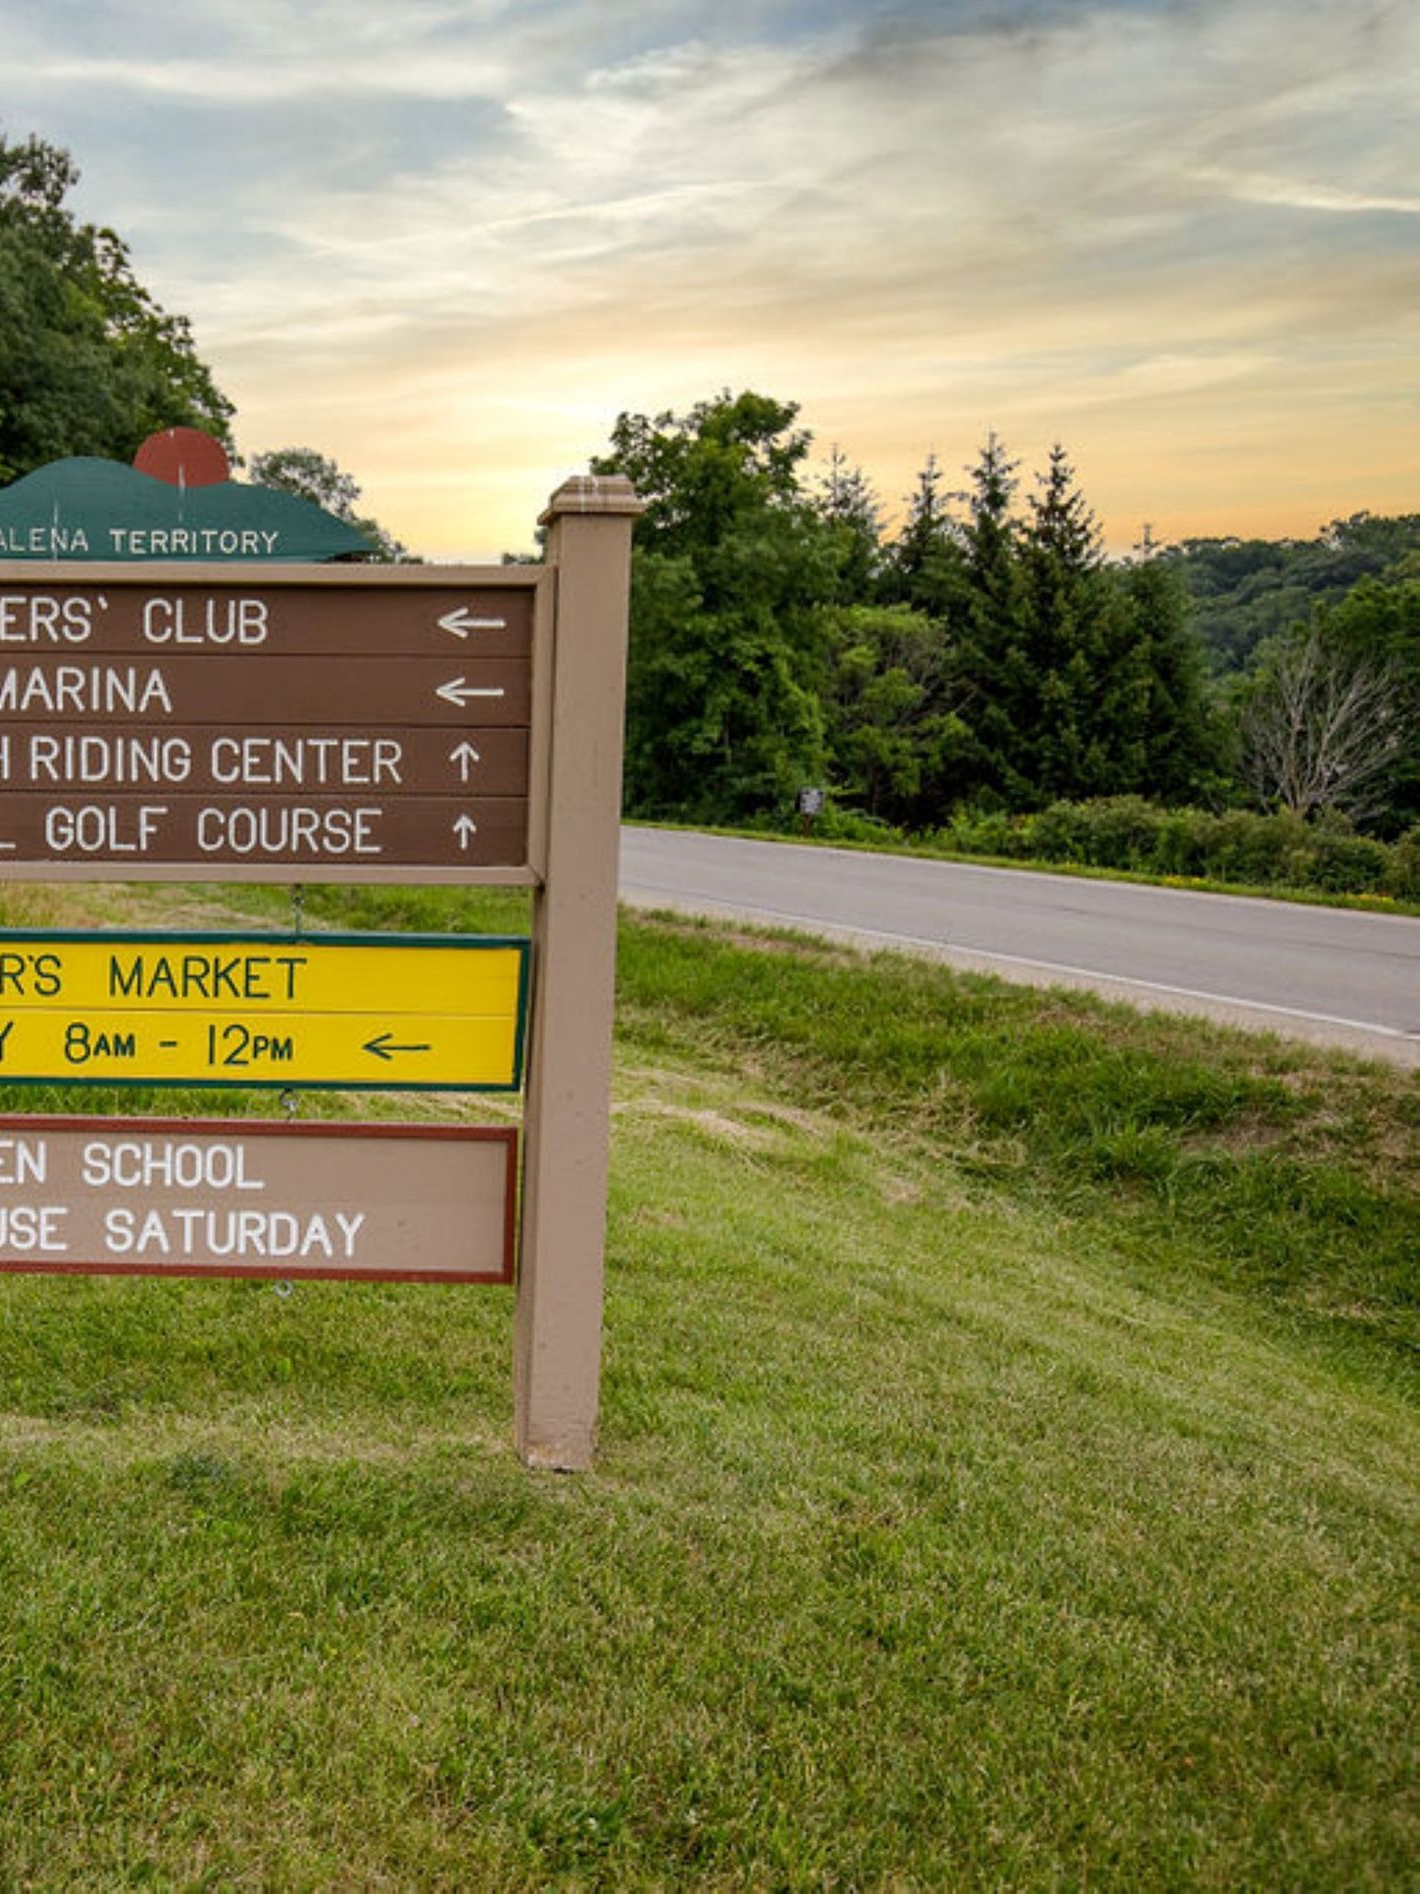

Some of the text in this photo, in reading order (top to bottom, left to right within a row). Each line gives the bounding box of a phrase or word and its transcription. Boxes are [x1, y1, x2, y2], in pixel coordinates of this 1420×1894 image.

[110, 529, 277, 553] TERRITORY
[145, 599, 267, 644] CLUB
[32, 737, 190, 781] RIDING
[212, 739, 401, 783] CENTER
[46, 806, 166, 850] GOLF
[198, 808, 381, 853] COURSE
[110, 956, 307, 998] MARKET
[65, 1023, 135, 1063] 8AM
[209, 1025, 292, 1065] 12PM
[83, 1143, 263, 1188] SCHOOL
[106, 1209, 363, 1256] SATURDAY
